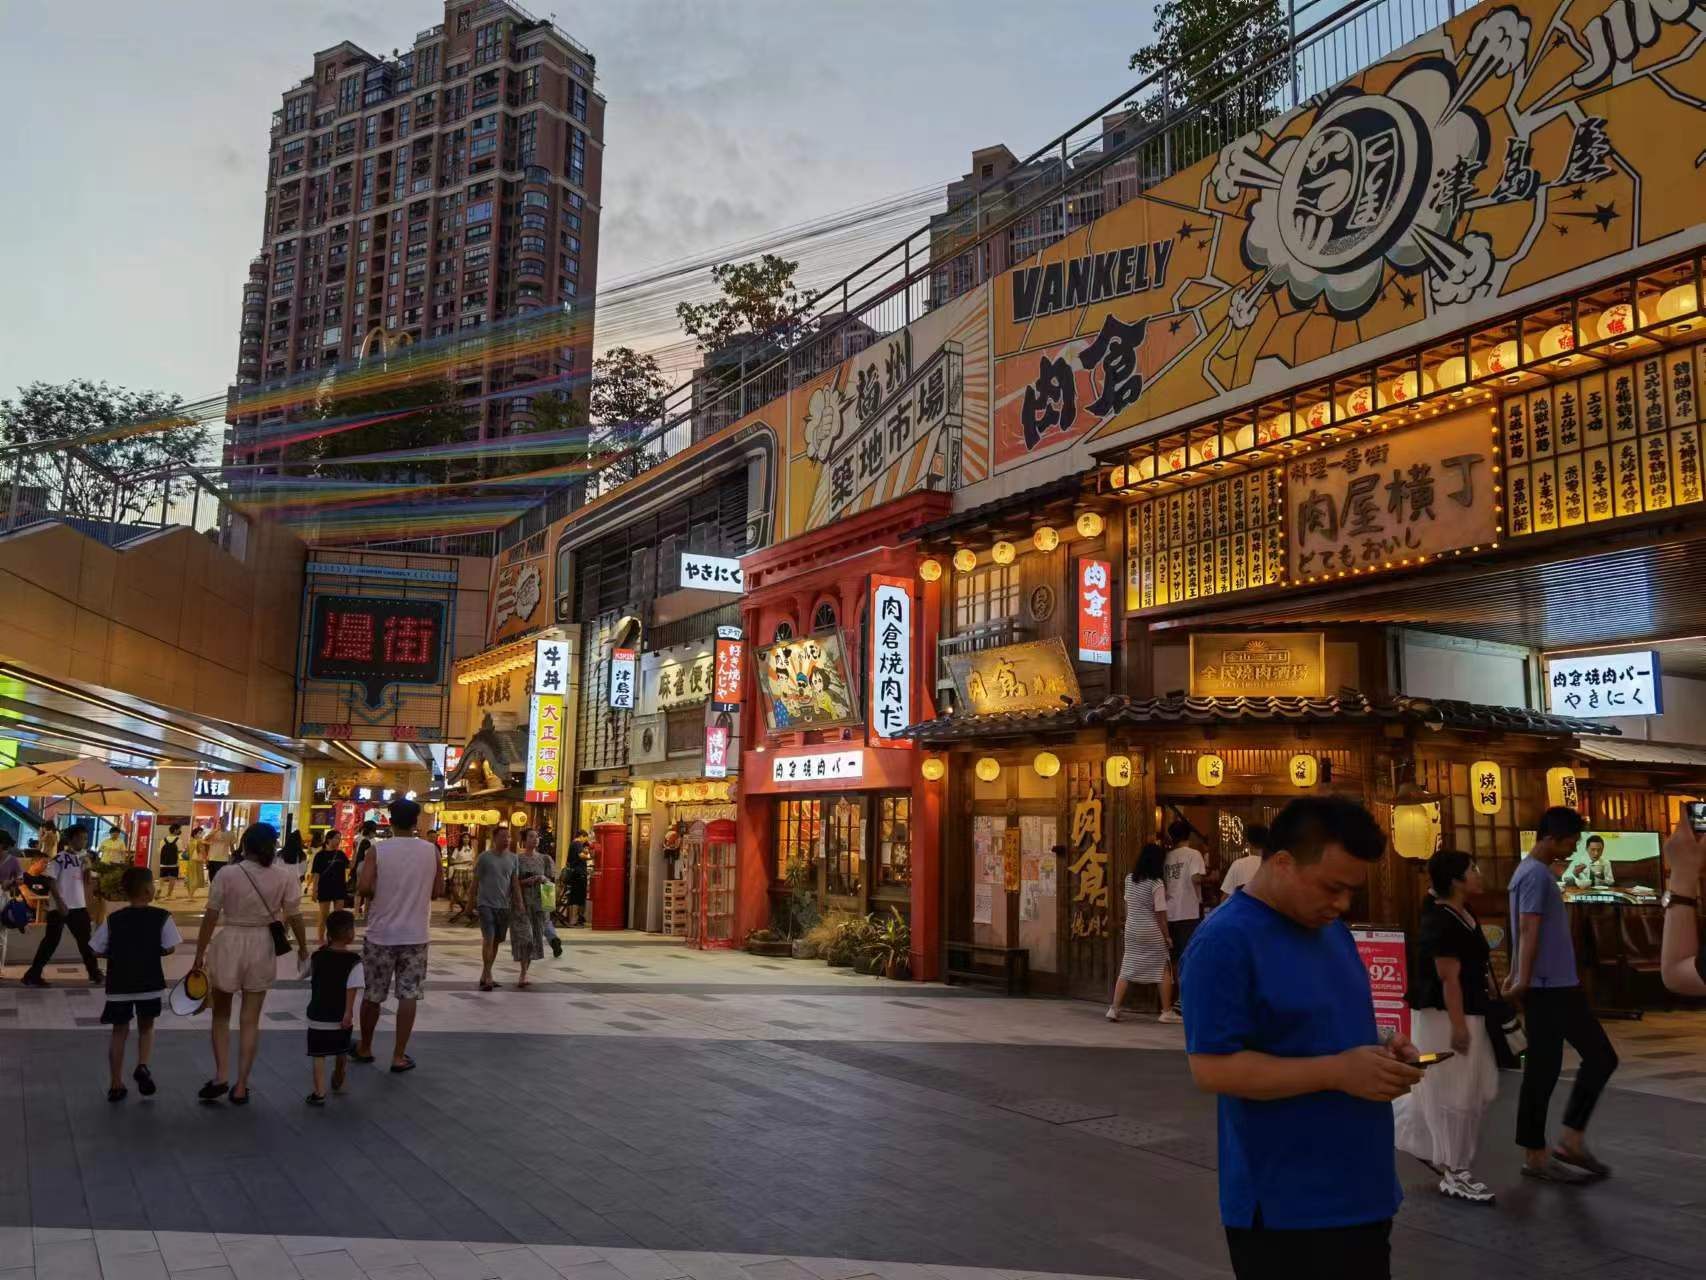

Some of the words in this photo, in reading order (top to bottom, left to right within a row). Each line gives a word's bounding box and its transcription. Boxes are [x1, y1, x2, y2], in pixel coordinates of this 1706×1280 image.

[1012, 238, 1174, 324] VANKELY
[1298, 453, 1486, 547] 肉屋横丁
[685, 561, 742, 585] やきにく
[322, 612, 433, 663] 漫街
[543, 646, 561, 692] 牛丼
[879, 596, 905, 729] 肉倉焼肉だ
[1552, 665, 1651, 688] 肉倉焼肉バー
[1564, 688, 1645, 710] やきにく
[538, 704, 559, 784] 大正酒場
[1480, 773, 1497, 806] 焼肉
